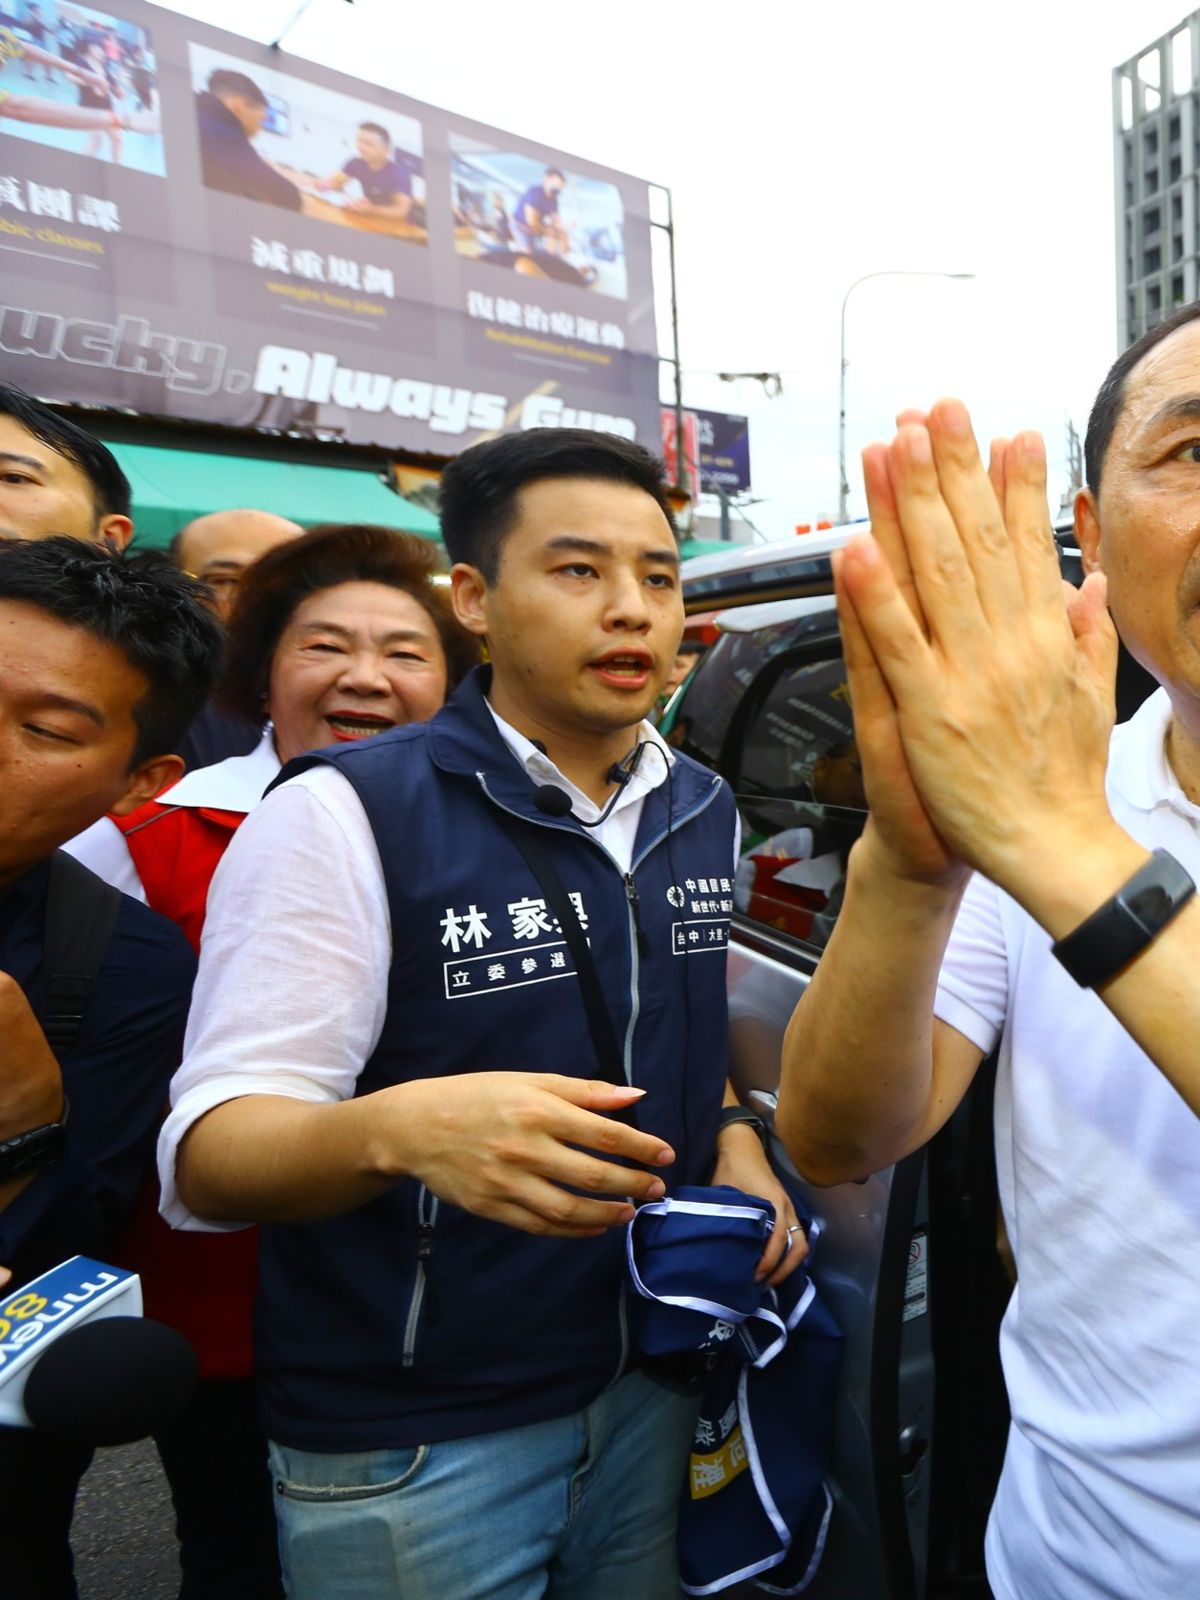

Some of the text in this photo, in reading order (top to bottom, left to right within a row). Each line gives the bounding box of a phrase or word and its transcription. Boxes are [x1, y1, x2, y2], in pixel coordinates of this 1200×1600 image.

[253, 344, 508, 434] Always
[685, 877, 735, 894] 中國國民
[677, 929, 699, 944] 台中
[452, 951, 567, 988] 立委參選
